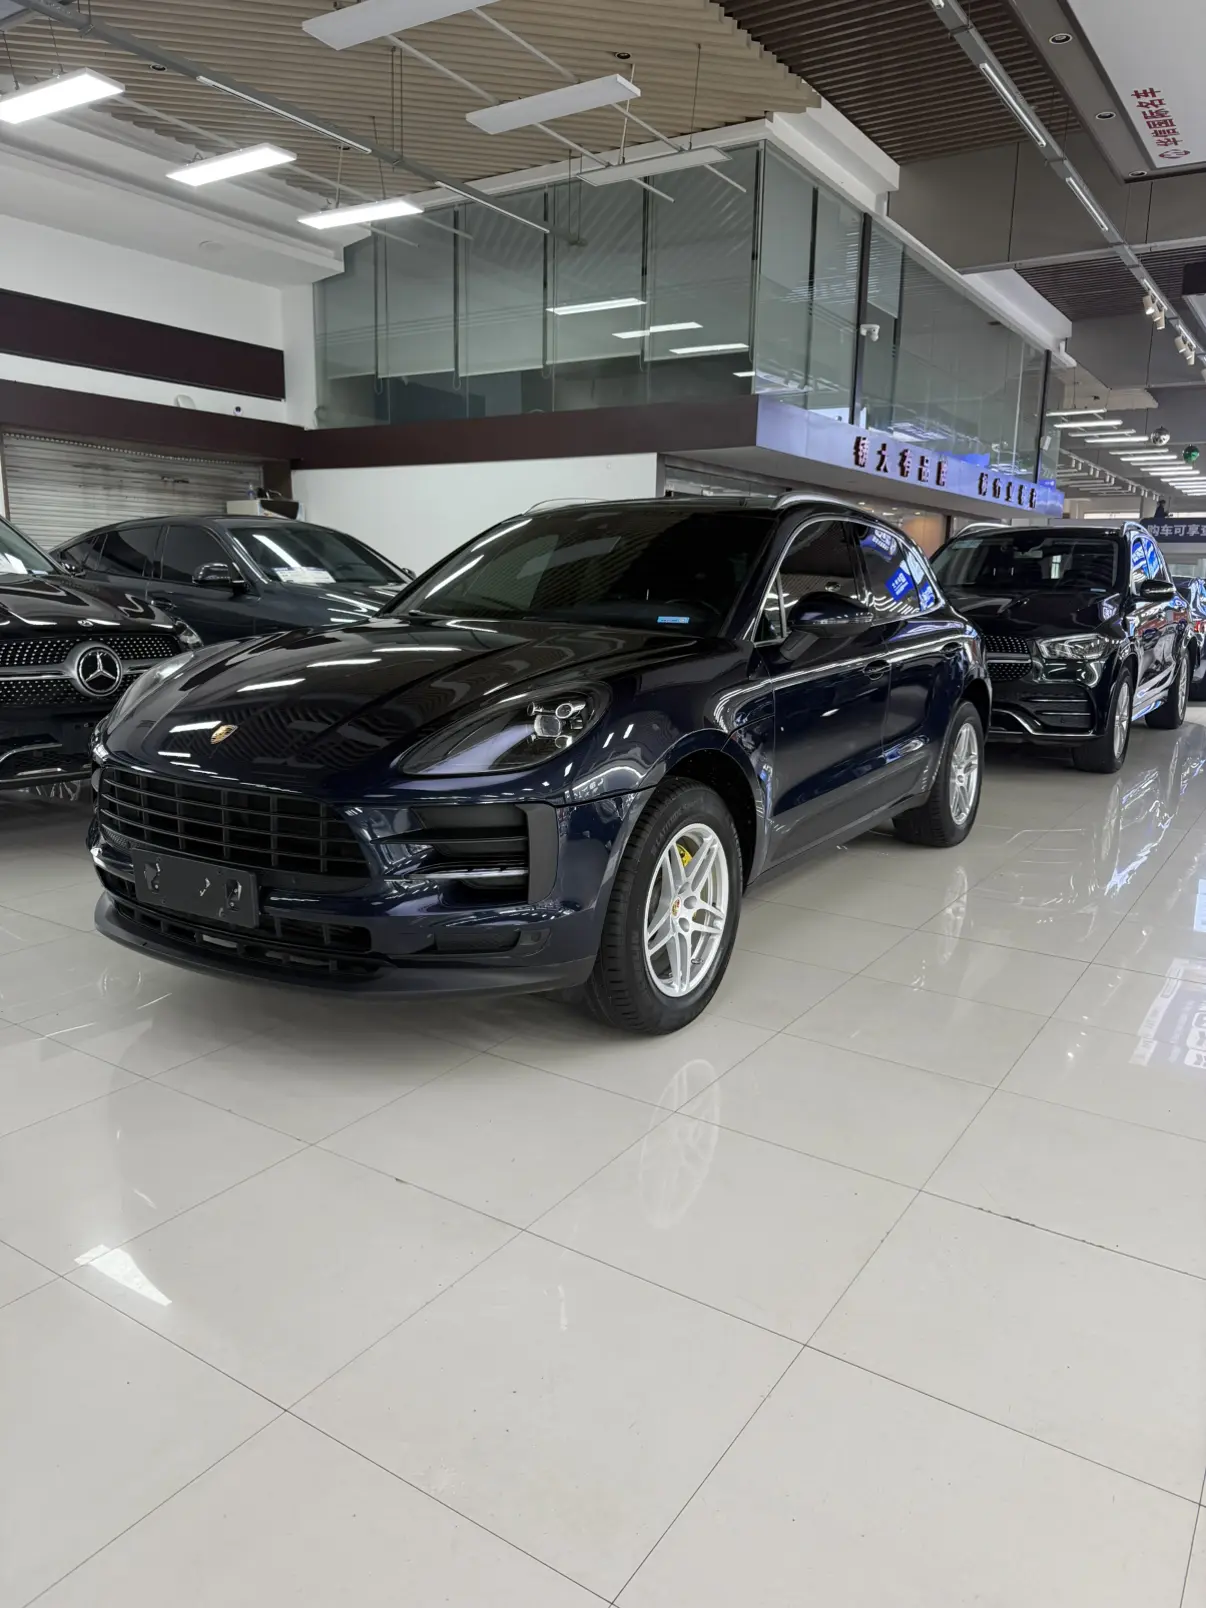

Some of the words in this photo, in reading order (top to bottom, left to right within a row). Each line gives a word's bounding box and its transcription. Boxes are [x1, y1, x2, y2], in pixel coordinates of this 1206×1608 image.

[1131, 88, 1183, 146] 华信国际名车
